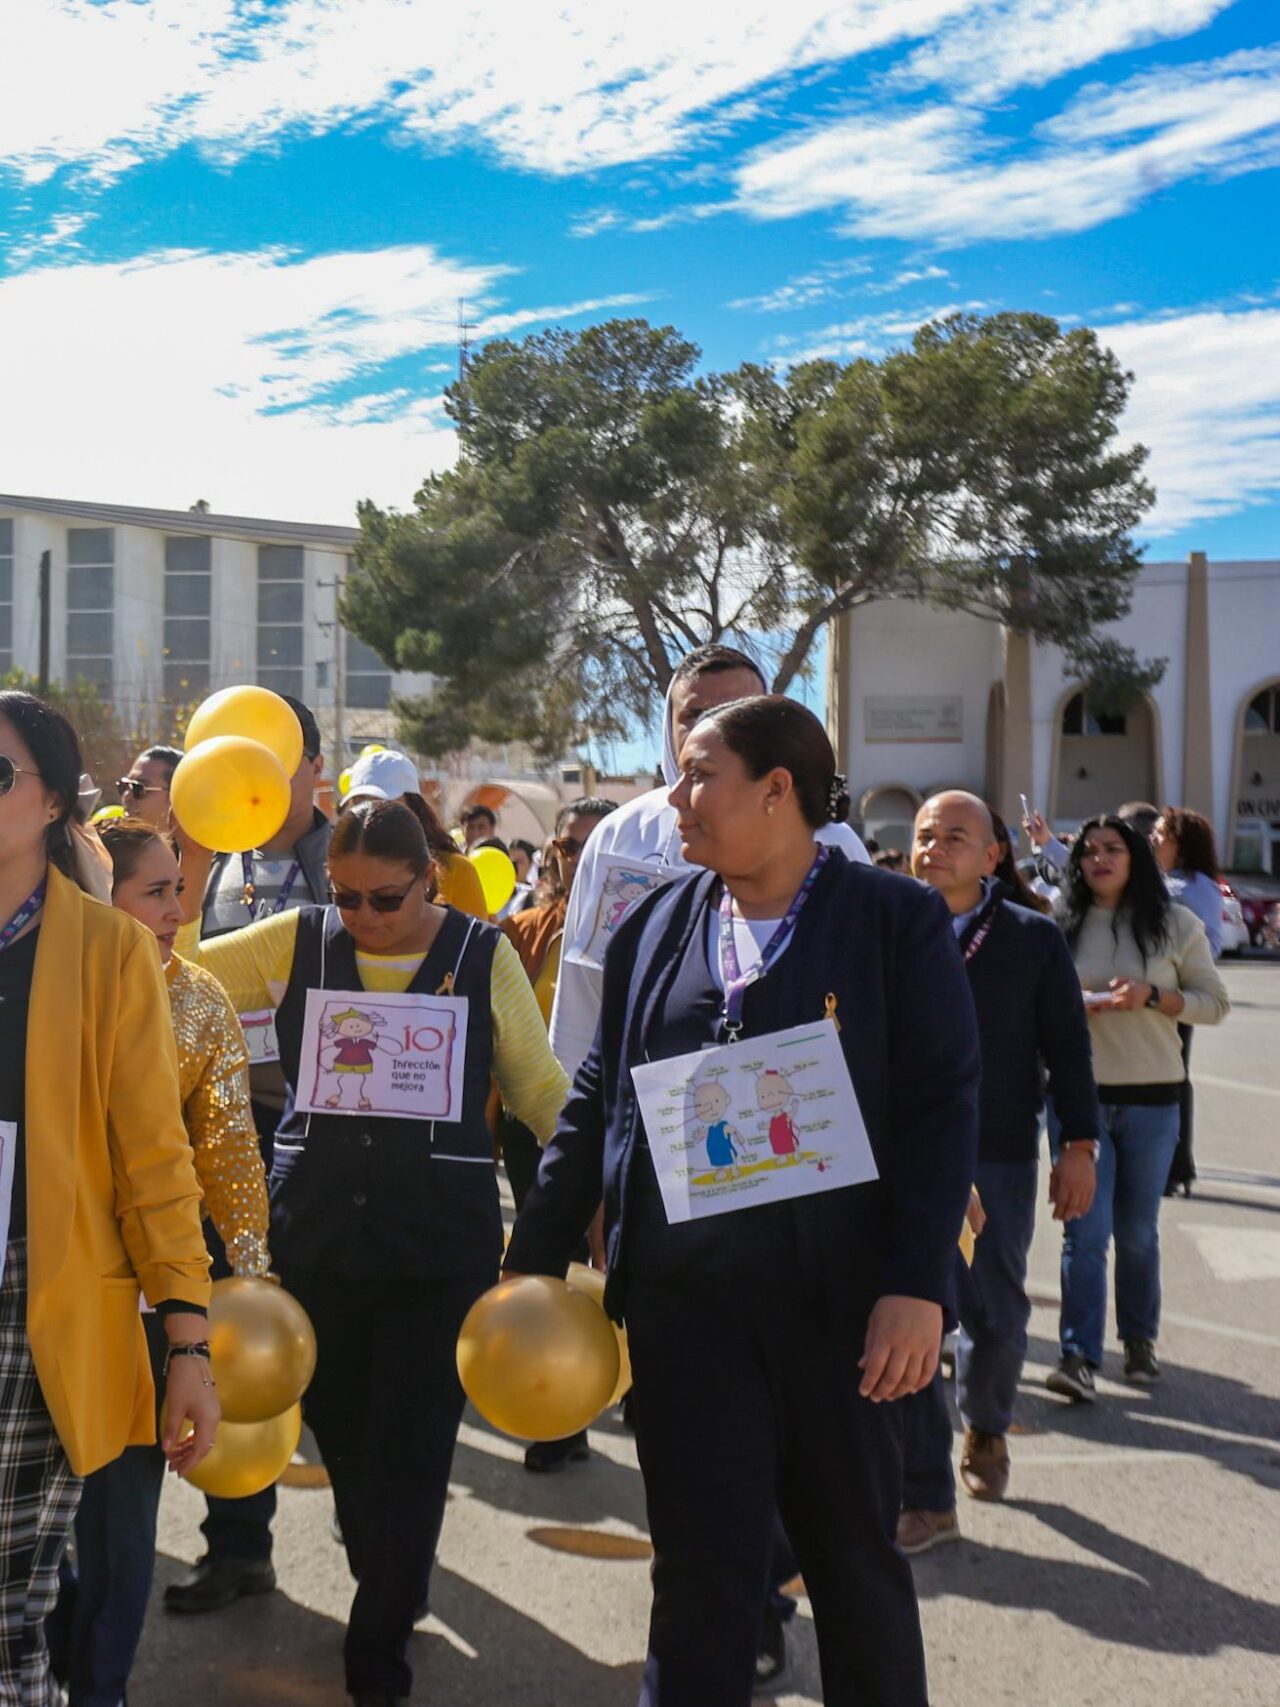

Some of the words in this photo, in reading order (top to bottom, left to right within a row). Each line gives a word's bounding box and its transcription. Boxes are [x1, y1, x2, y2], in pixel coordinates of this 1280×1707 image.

[404, 1025, 444, 1051] 10
[393, 1059, 440, 1071] Infección
[391, 1071, 411, 1081] que
[413, 1073, 426, 1081] no
[391, 1081, 425, 1093] mejora
